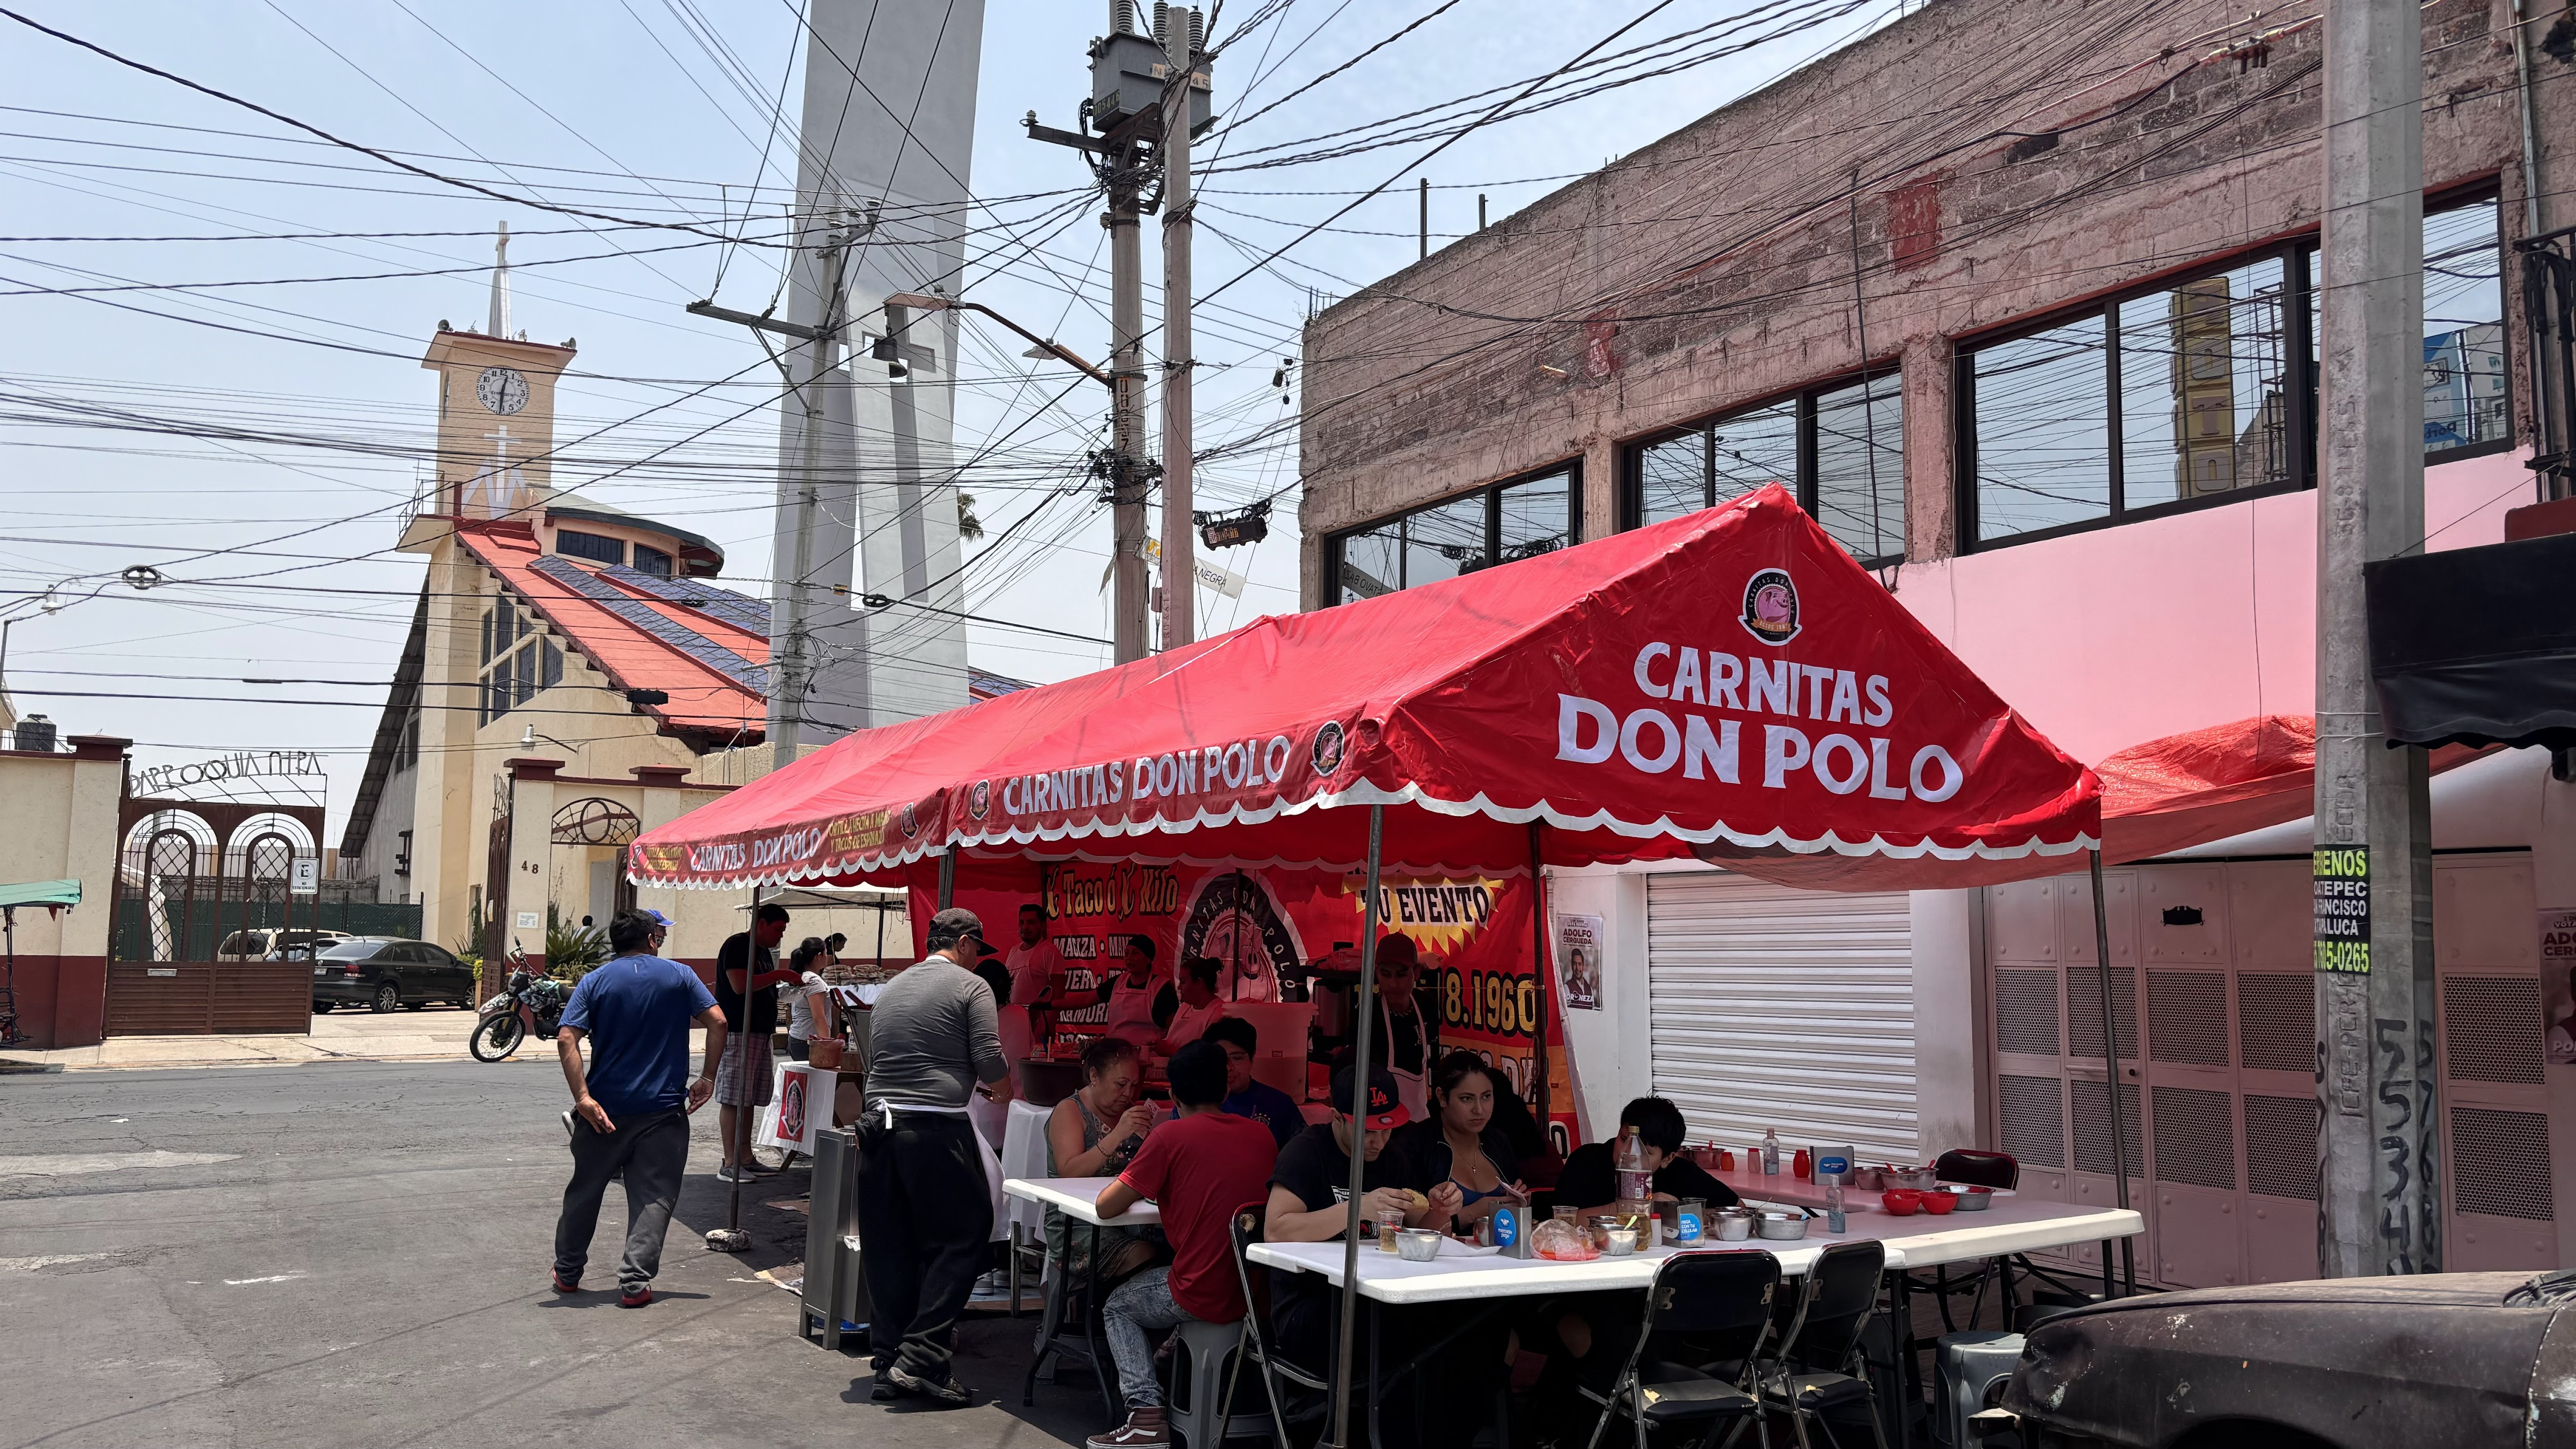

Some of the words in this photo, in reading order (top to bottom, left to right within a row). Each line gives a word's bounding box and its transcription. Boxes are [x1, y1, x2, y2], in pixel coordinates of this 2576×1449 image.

[1198, 568, 1227, 588] NEGRA
[1760, 620, 1774, 630] DESDE
[1633, 641, 1893, 727] CARNITAS
[1554, 693, 1742, 785] DON
[1762, 724, 1964, 803] POLO
[129, 752, 261, 800] PARROQUIA
[1004, 761, 1123, 816] CARNITAS
[1132, 749, 1198, 801] DON
[1203, 735, 1291, 792] POLO
[828, 819, 852, 837] ORTILLA
[752, 834, 783, 868] DON
[782, 828, 821, 863] POLO
[831, 839, 835, 853] Y
[836, 836, 853, 852] TACOS
[852, 833, 860, 849] DE
[860, 829, 884, 848] ESPINAZO
[691, 843, 746, 872] CARNITAS
[2314, 850, 2367, 877] ERRENOS
[301, 865, 309, 877] E
[1063, 873, 1103, 914] Taco
[1139, 869, 1179, 912] Kilo
[2314, 881, 2367, 897] OATEPEC
[1396, 886, 1489, 923] EVENTO
[1563, 928, 1592, 938] ADOLFO
[2314, 918, 2359, 936] XTAPALUCA
[1265, 927, 1296, 989] POLO
[2544, 946, 2576, 956] CER
[2553, 1040, 2576, 1052] PO
[1370, 1087, 1388, 1106] LA
